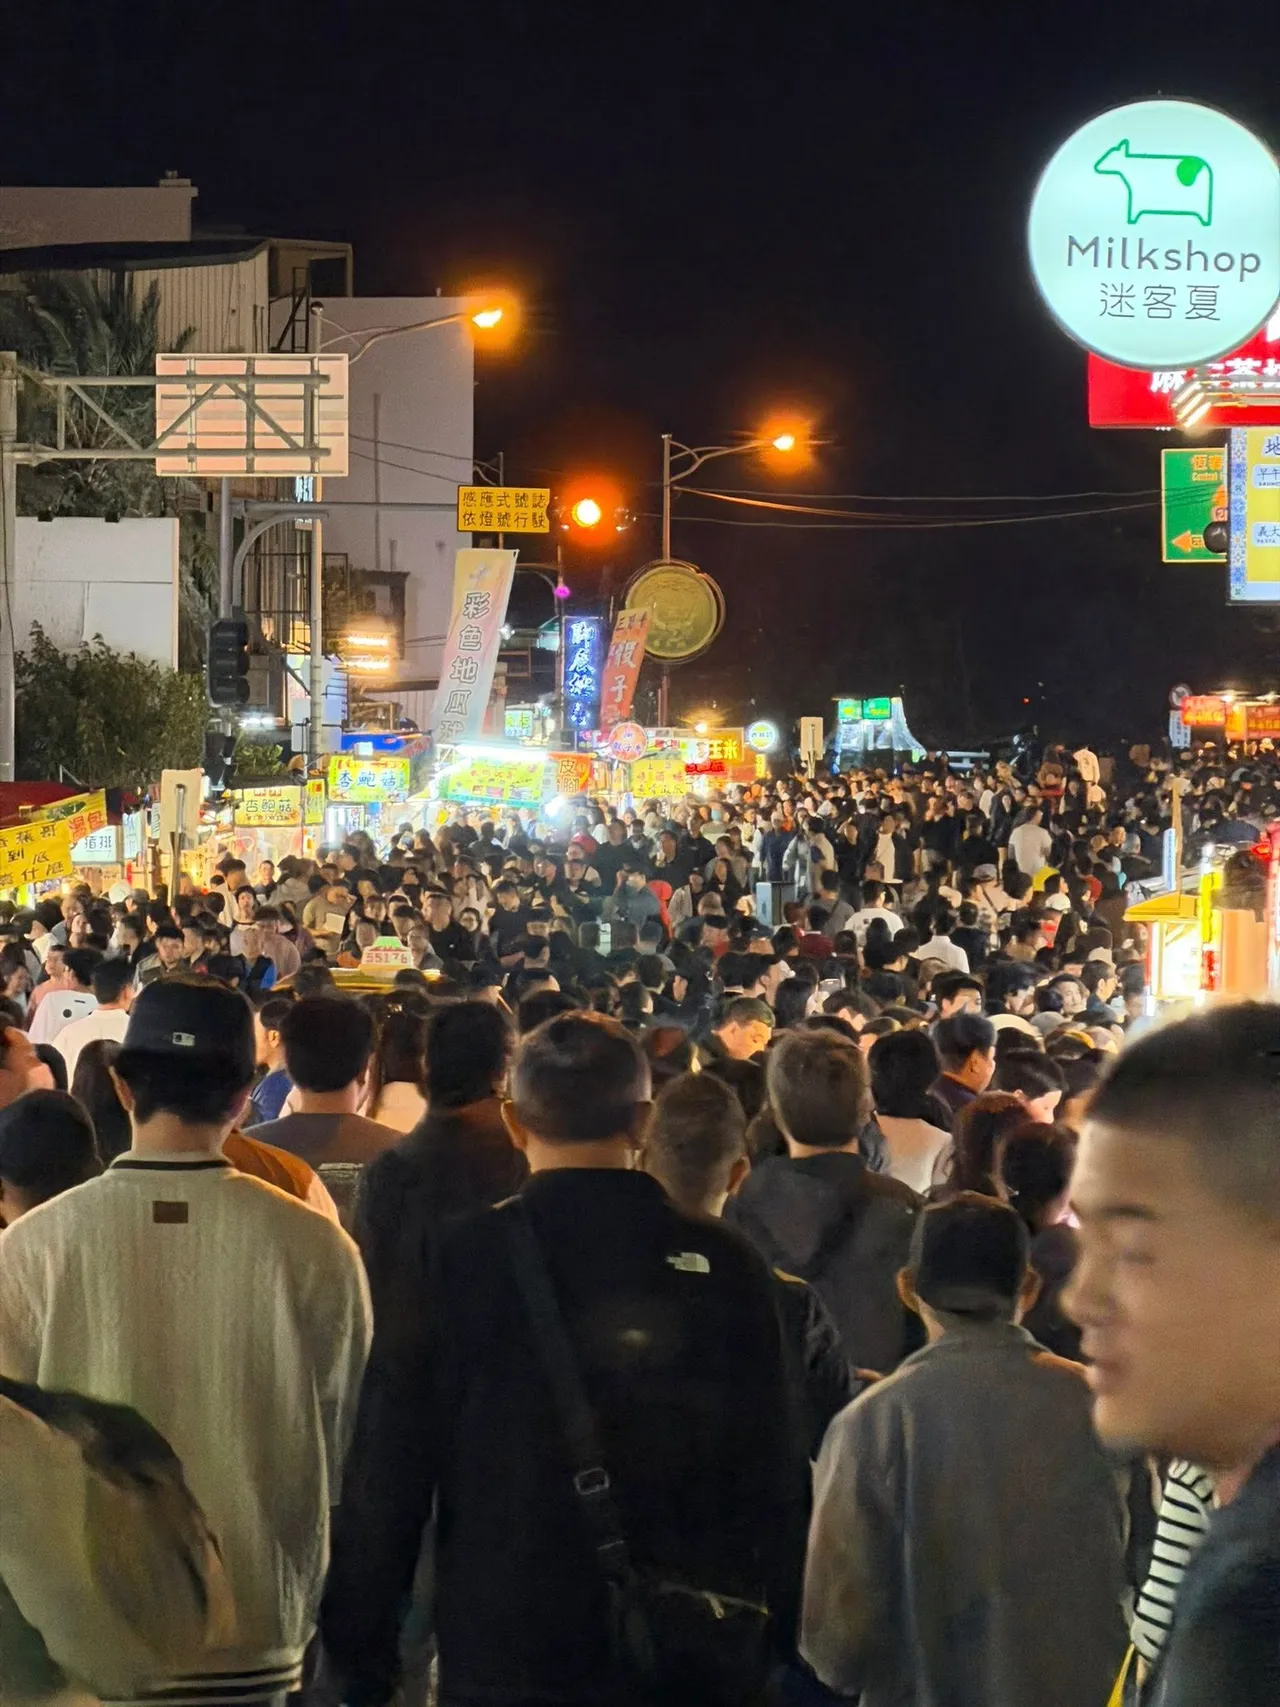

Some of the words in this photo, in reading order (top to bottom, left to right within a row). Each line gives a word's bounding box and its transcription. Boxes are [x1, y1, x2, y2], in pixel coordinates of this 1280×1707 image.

[1067, 235, 1261, 282] Milkshop
[1099, 282, 1221, 321] 迷客夏
[463, 491, 547, 509] 感應式號誌
[463, 511, 547, 528] 依燈號行駛
[338, 770, 396, 789] 杏鮑菇
[245, 799, 292, 813] 杏鮑菇
